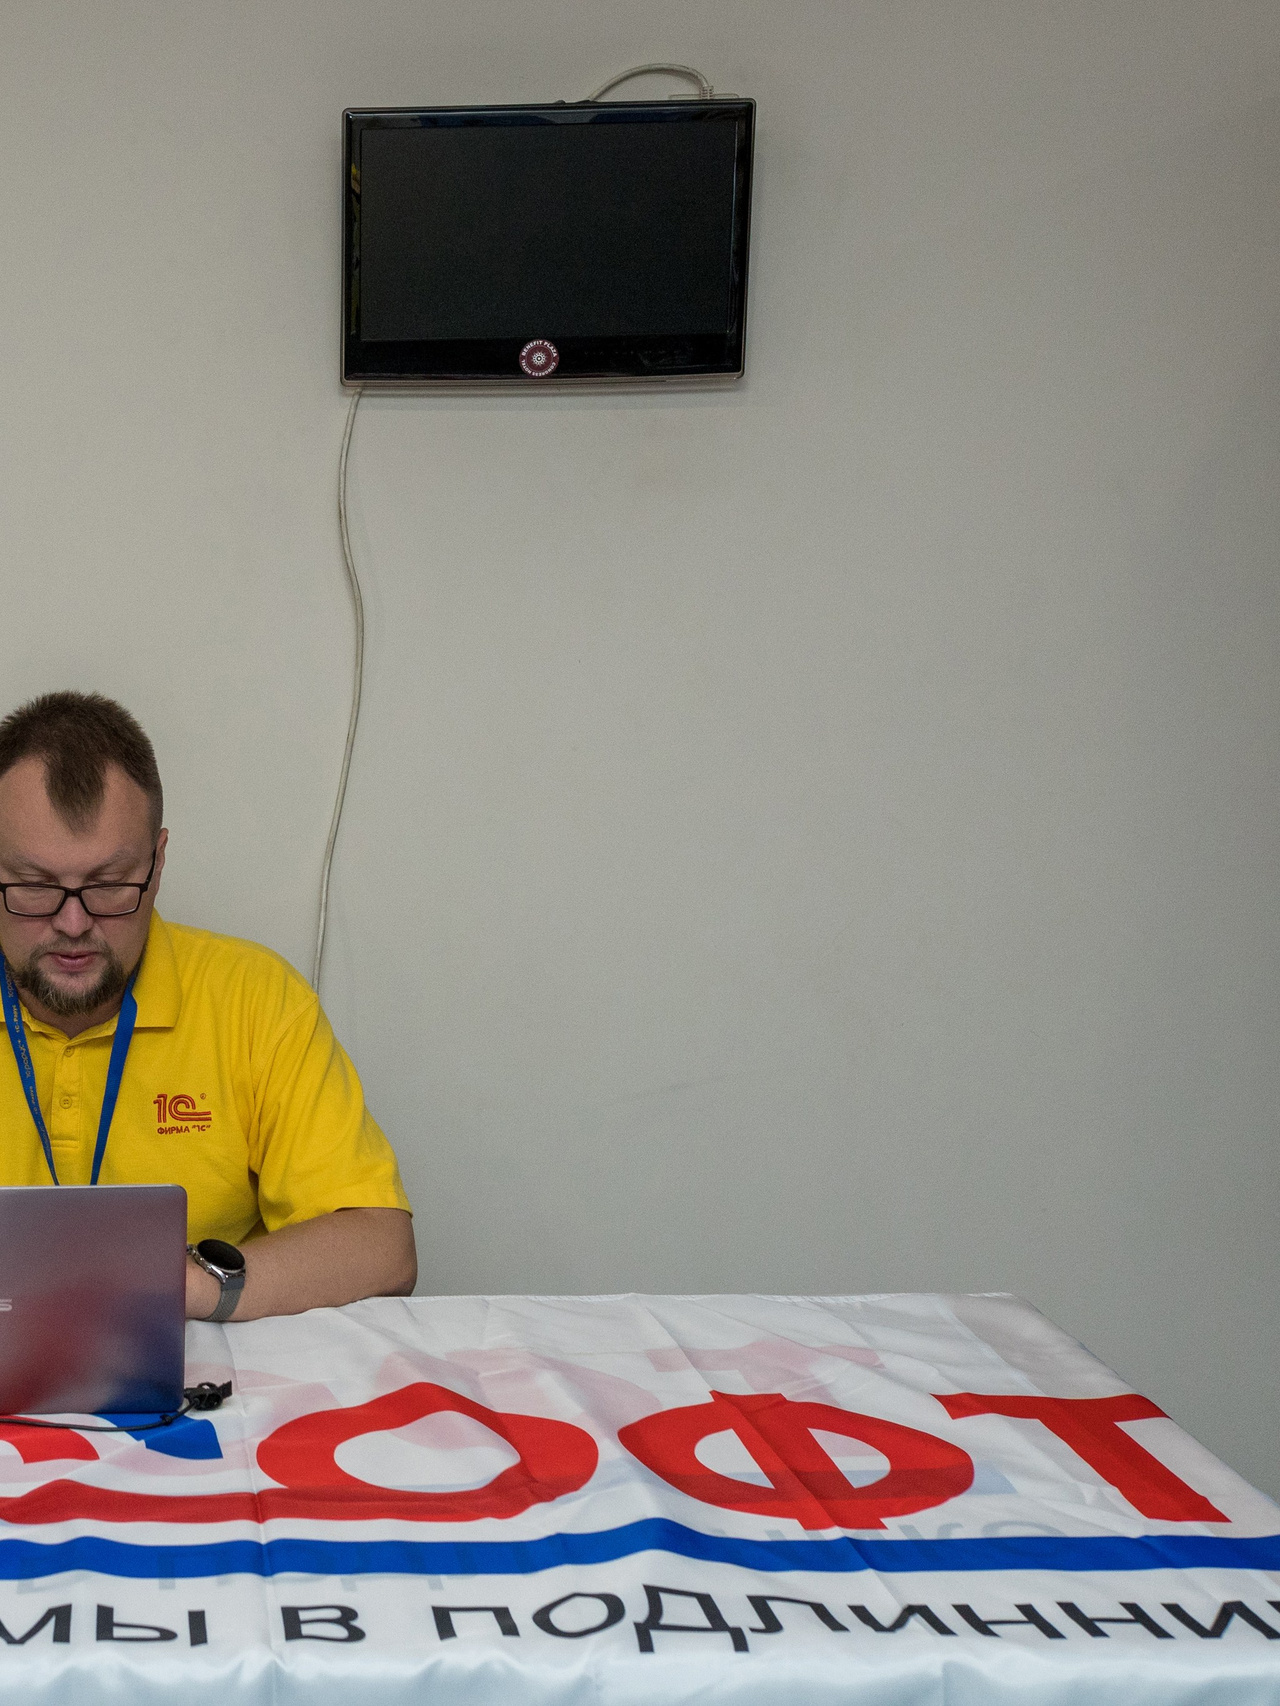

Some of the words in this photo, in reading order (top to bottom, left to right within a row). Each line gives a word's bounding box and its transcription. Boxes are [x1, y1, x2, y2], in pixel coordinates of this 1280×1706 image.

[521, 341, 543, 357] BENEFIT
[543, 341, 558, 357] PLAZA
[157, 1125, 190, 1135] ФИРМА
[280, 1603, 367, 1643] в
[430, 1584, 1280, 1654] подлинни
